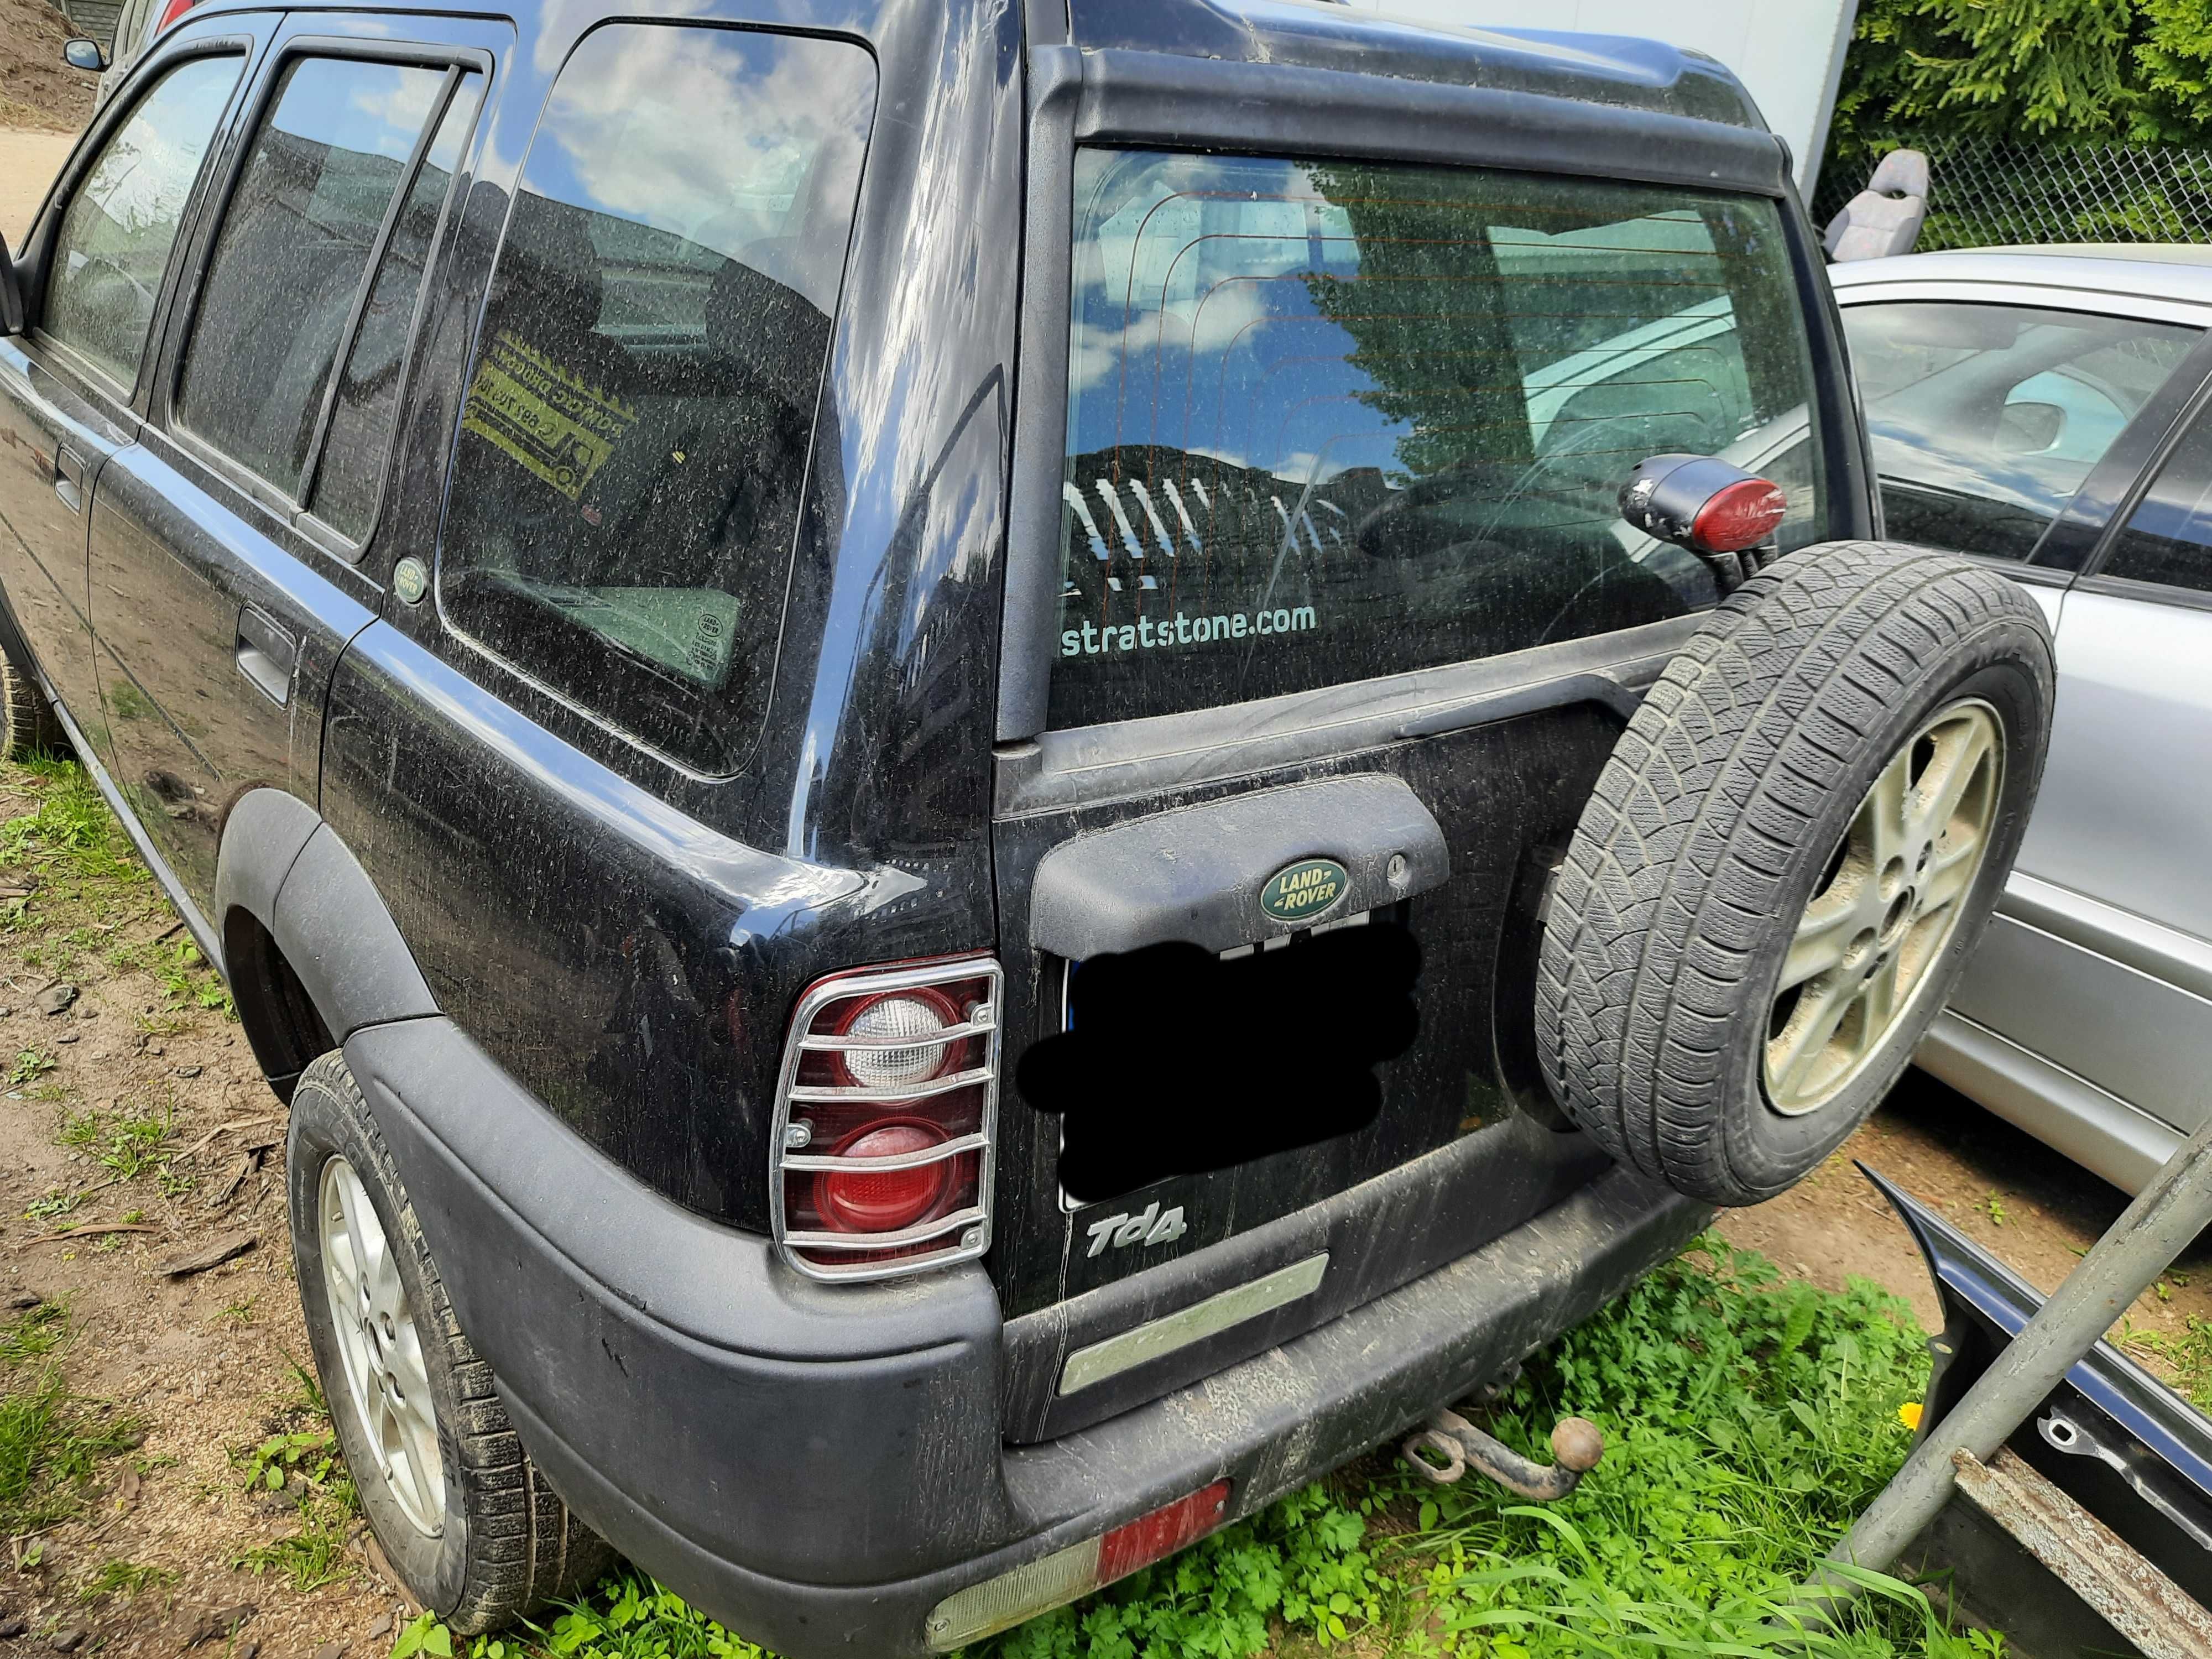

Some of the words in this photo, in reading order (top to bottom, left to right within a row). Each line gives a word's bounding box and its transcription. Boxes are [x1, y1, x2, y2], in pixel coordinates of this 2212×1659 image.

[400, 565, 415, 581] LAND
[398, 576, 417, 594] ROVER
[703, 616, 716, 625] LAND
[1061, 606, 1316, 656] stratstone.com
[1279, 868, 1322, 894] LAND
[1284, 881, 1337, 911] ROVER
